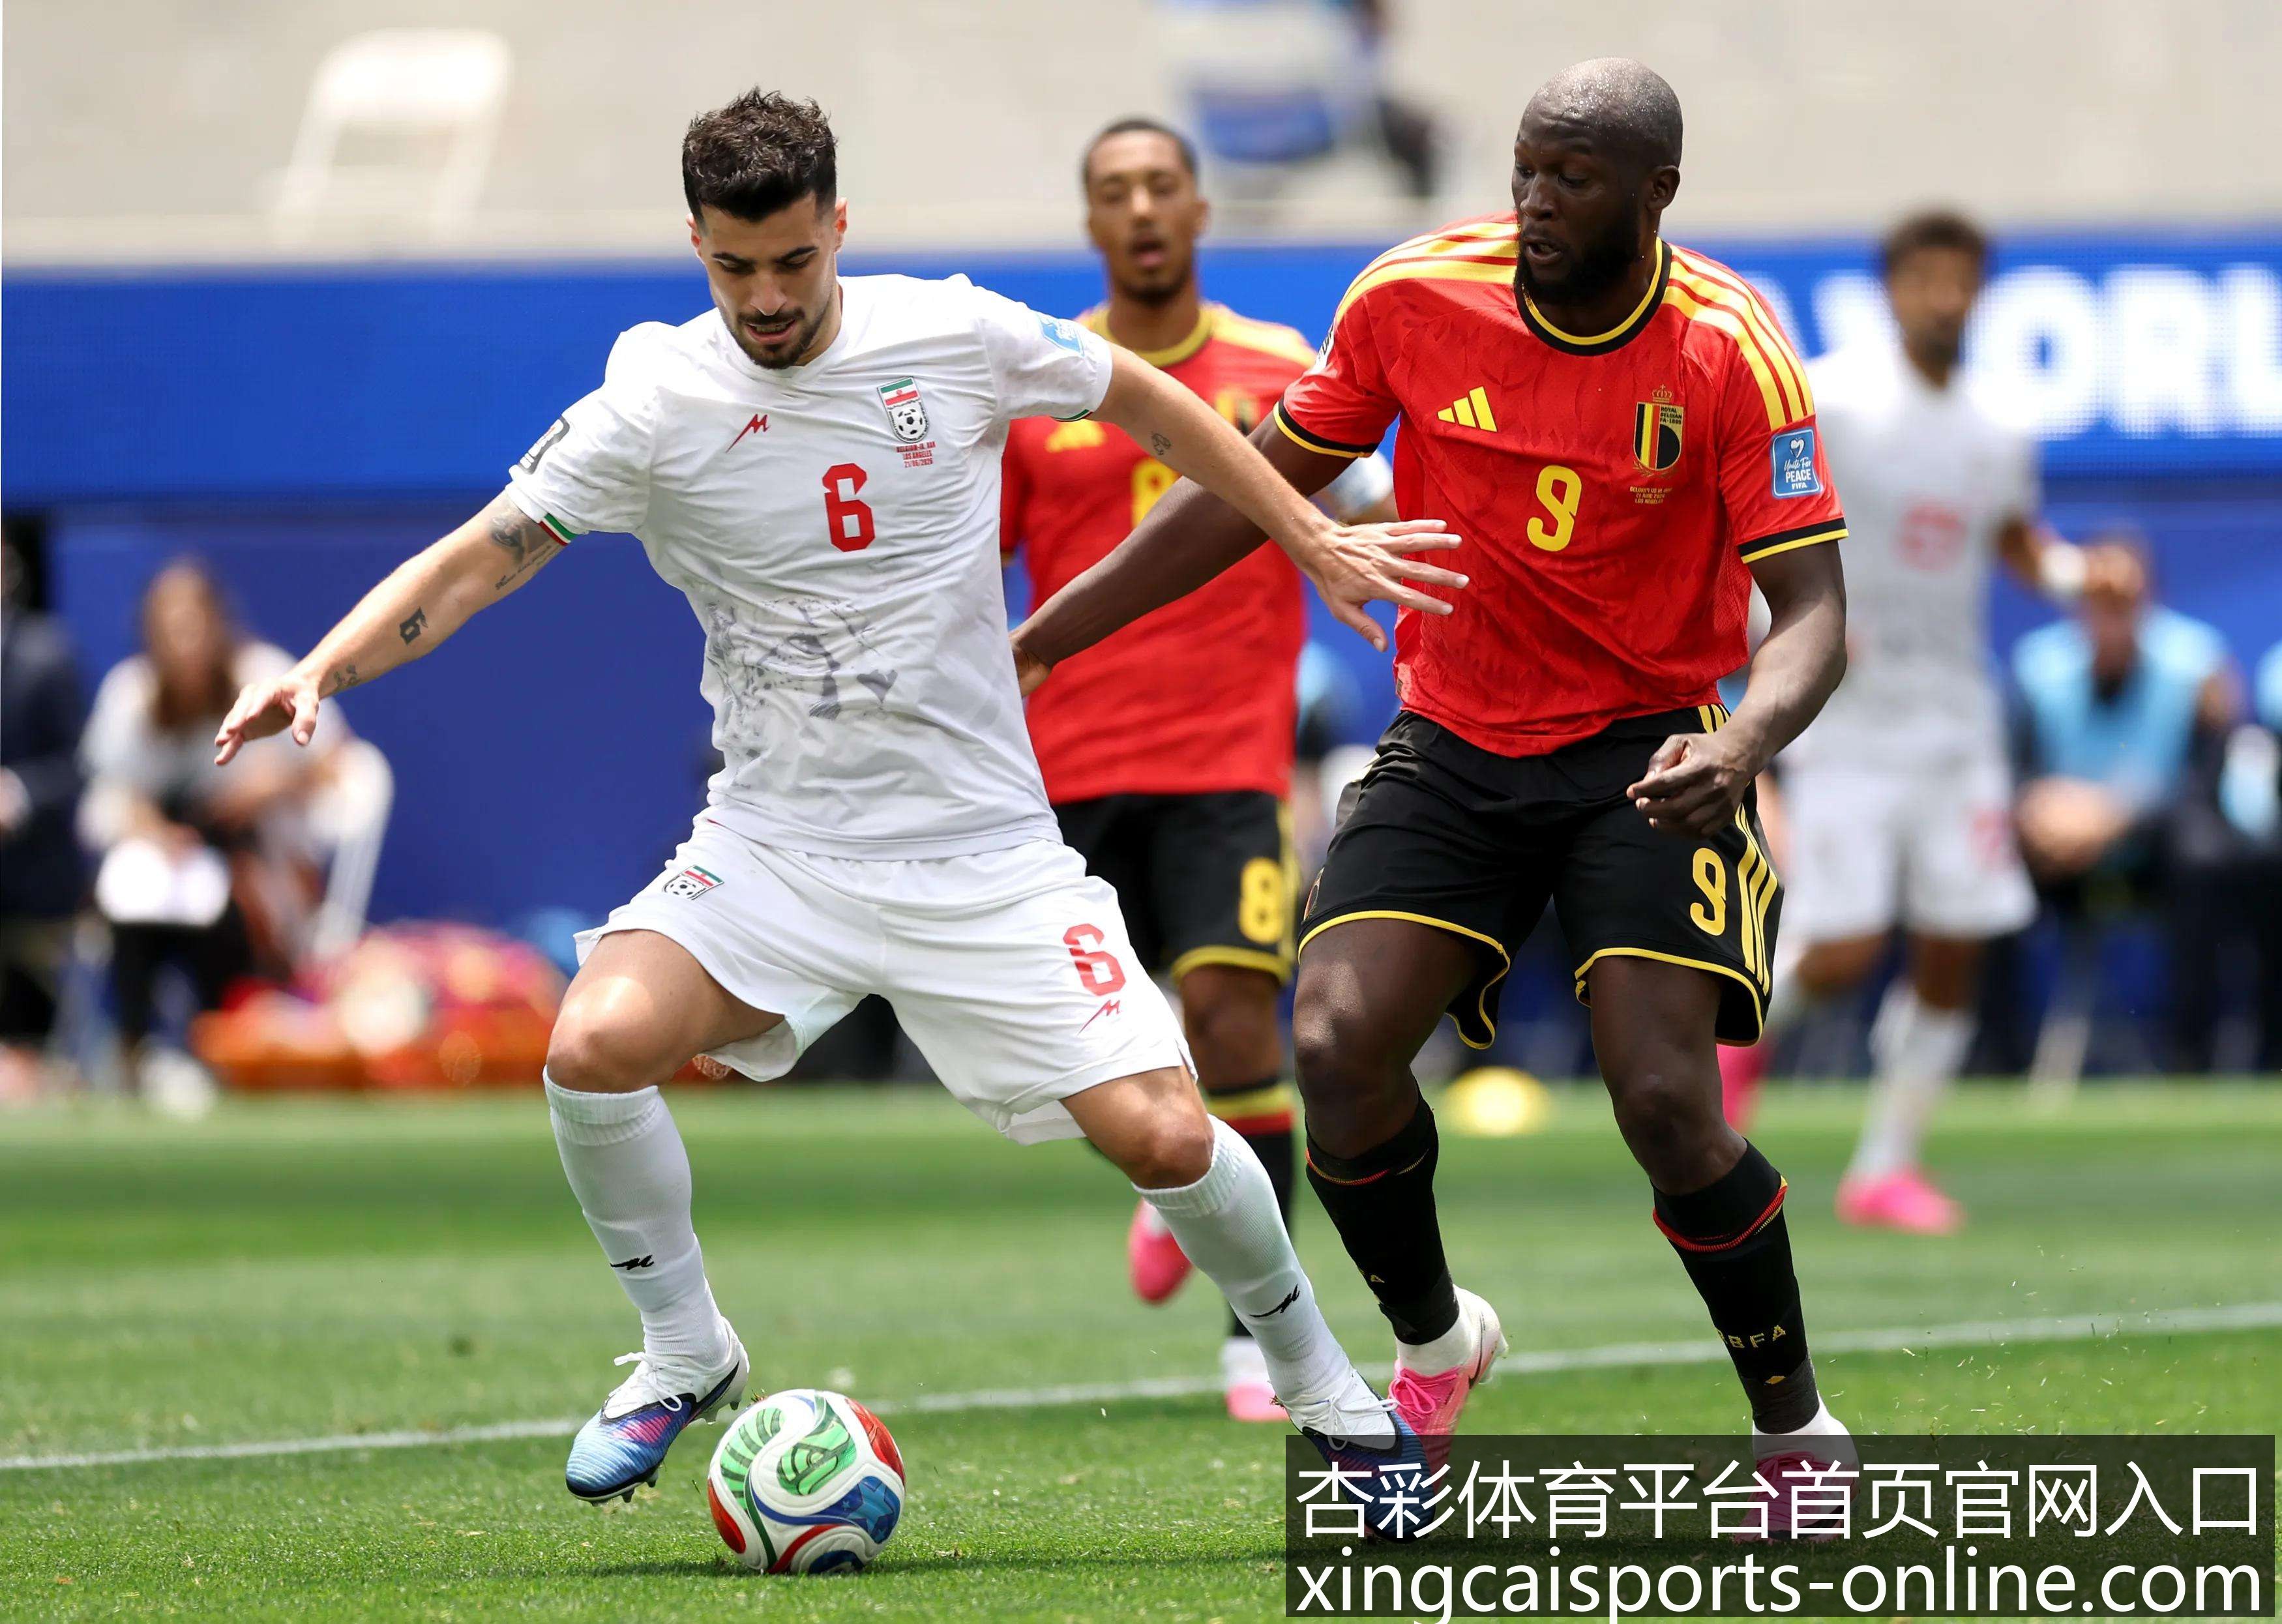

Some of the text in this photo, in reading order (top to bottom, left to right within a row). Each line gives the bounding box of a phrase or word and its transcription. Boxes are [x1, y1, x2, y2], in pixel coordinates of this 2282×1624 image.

[822, 463, 876, 552] 6
[1527, 465, 1582, 552] 9
[1785, 469, 1811, 483] PEACE
[1791, 481, 1807, 490] FIFA
[1239, 857, 1285, 944] 8
[1690, 848, 1726, 936] 9
[1063, 923, 1127, 996] 6
